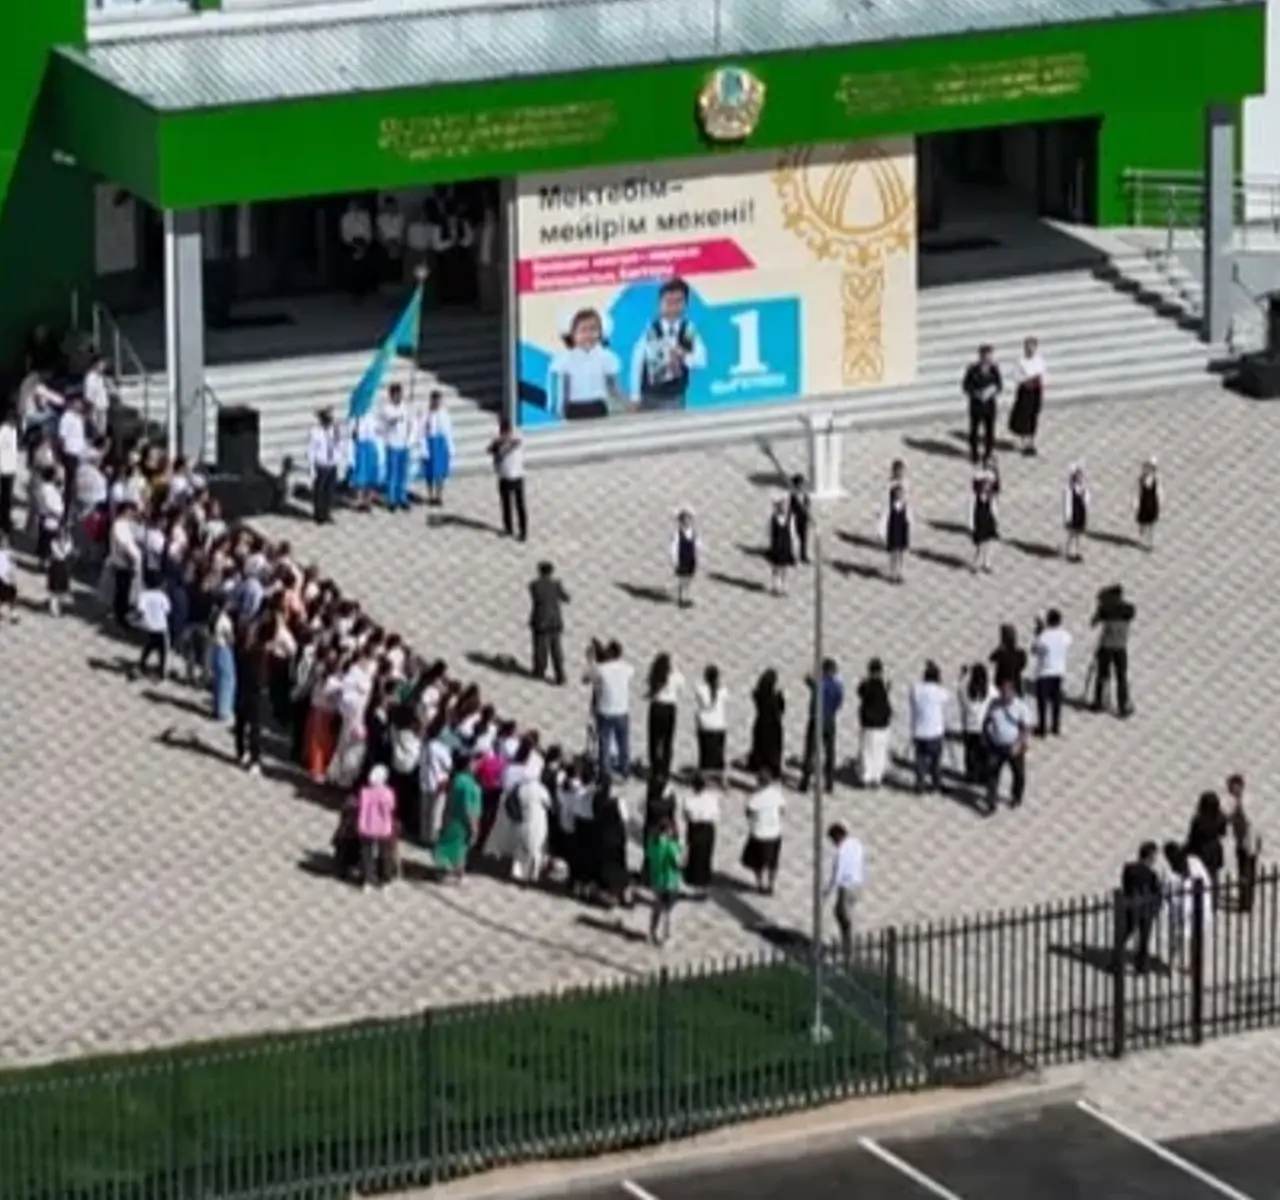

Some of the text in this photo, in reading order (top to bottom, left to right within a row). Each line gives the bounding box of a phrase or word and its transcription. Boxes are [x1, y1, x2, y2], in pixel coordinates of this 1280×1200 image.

[539, 202, 755, 245] мейірім мекені!
[729, 309, 768, 374] 1
